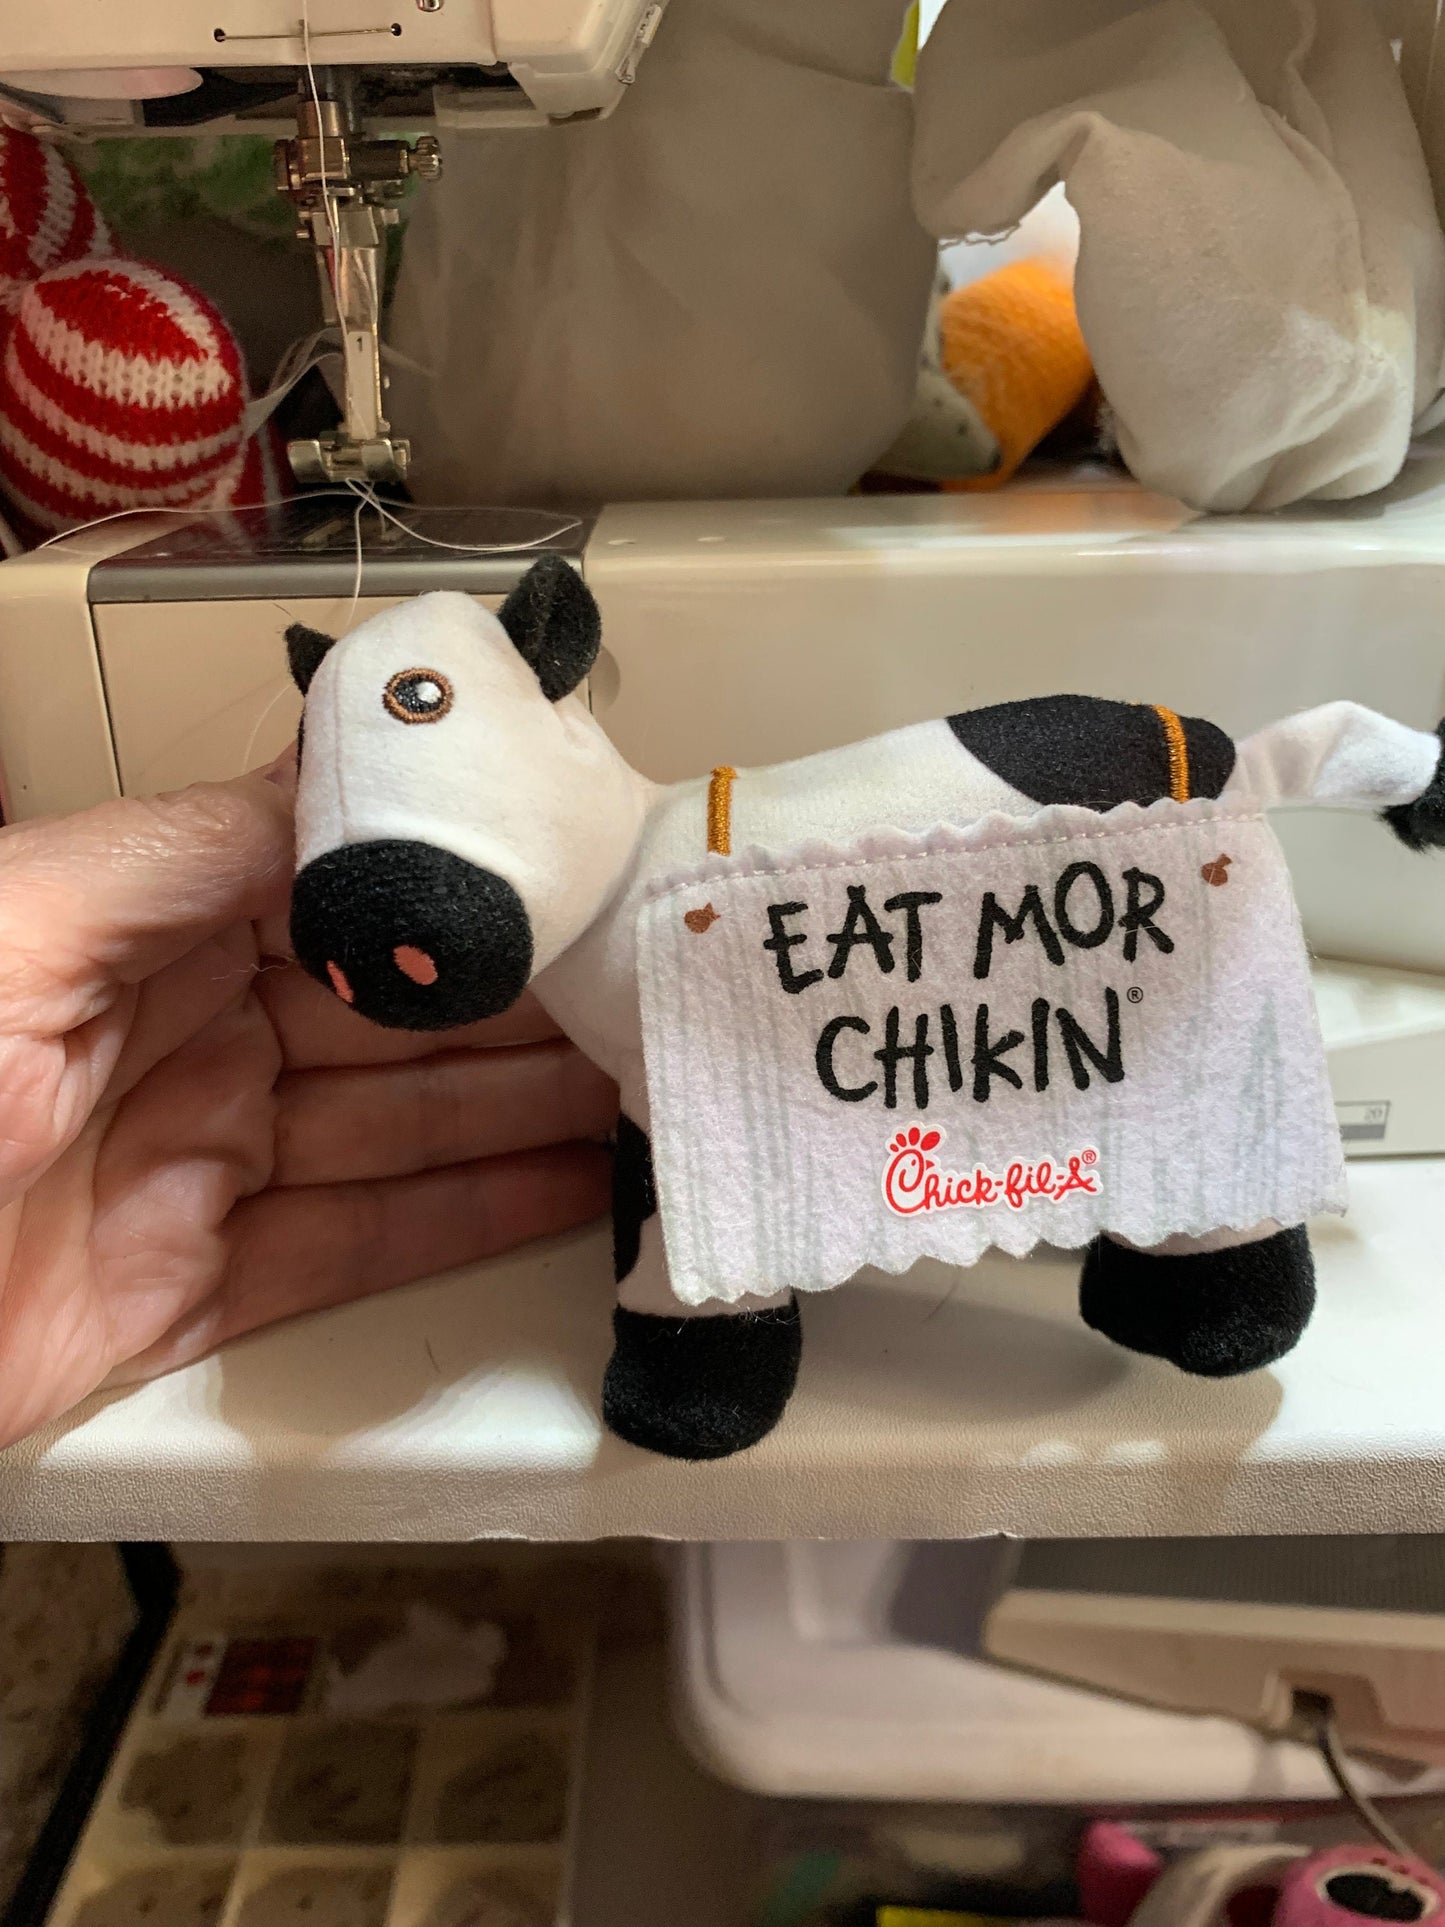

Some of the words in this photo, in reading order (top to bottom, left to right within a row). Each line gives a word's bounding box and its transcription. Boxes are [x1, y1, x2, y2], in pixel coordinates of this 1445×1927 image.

[357, 337, 363, 352] 1
[763, 884, 943, 994] EAT
[973, 861, 1175, 980] MOR
